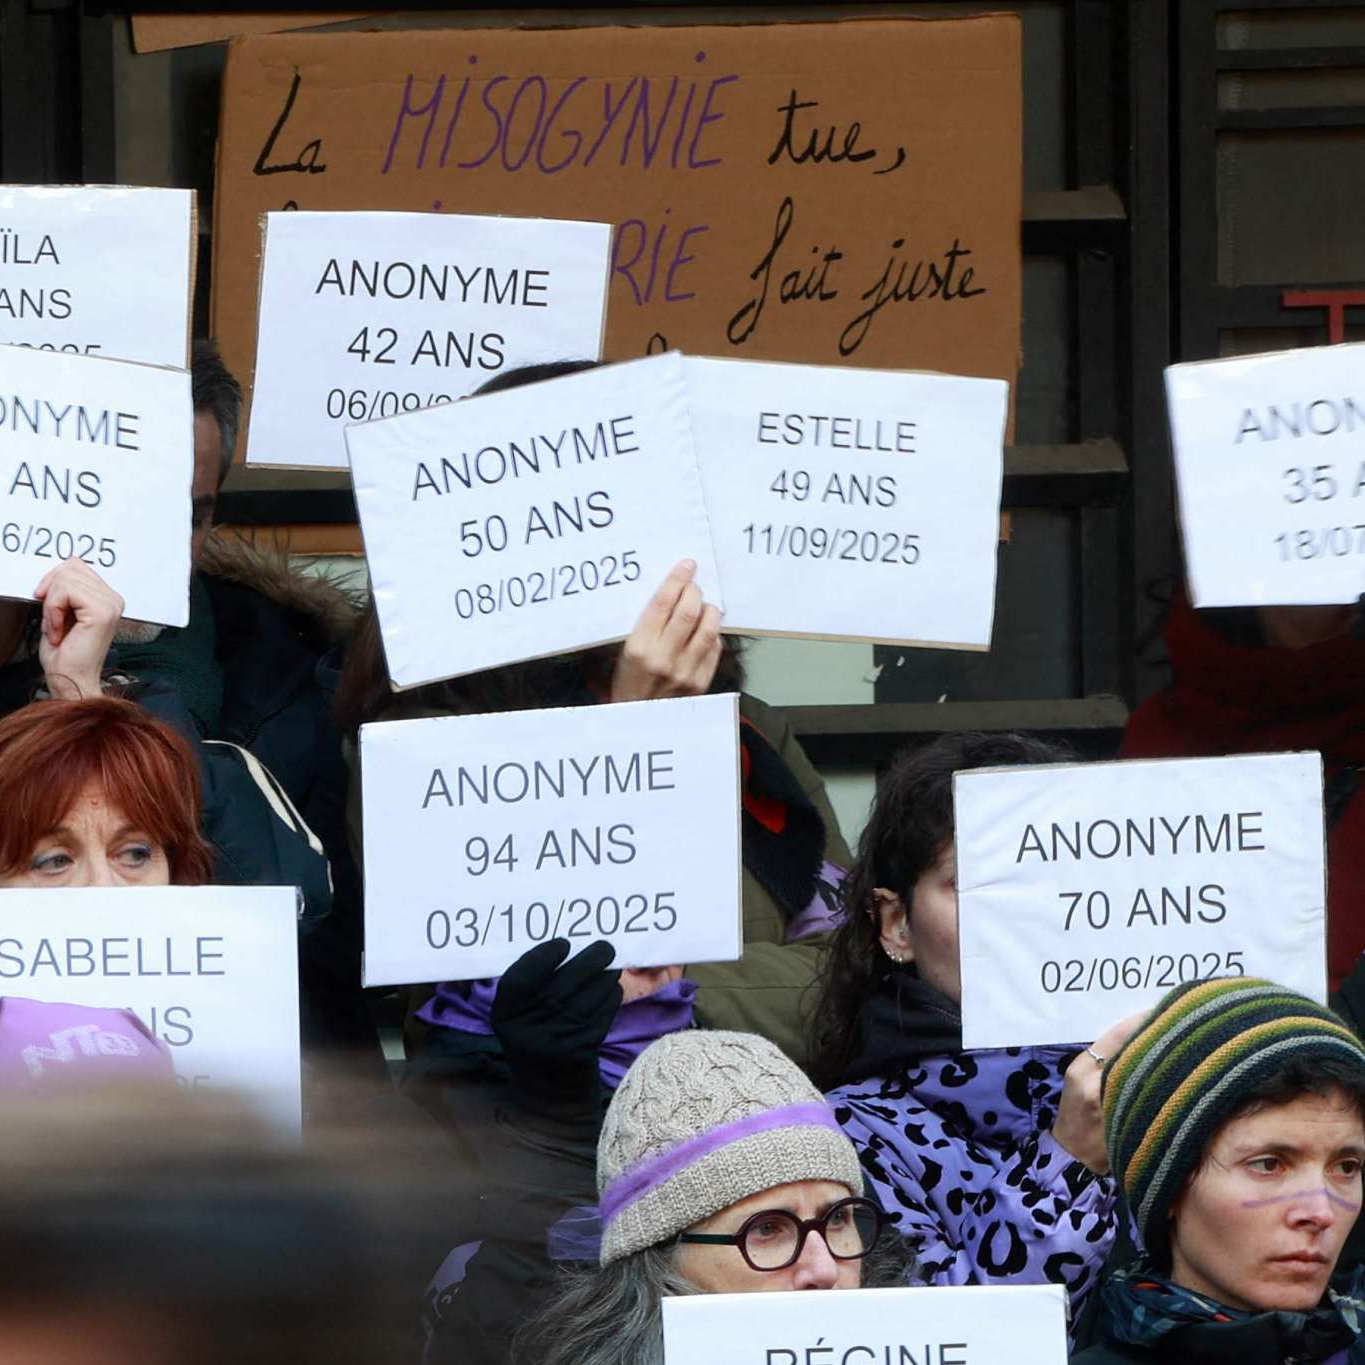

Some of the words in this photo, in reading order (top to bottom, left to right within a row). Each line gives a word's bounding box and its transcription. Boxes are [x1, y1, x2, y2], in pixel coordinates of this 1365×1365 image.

[252, 65, 328, 178] La
[767, 88, 907, 175] tue,
[315, 258, 550, 307] ANONYME
[726, 197, 844, 347] fait
[837, 238, 987, 357] juste
[347, 326, 398, 364] 42
[410, 330, 507, 371] ANS
[757, 412, 917, 453] ESTELLE
[412, 415, 645, 502] ANONYME
[9, 462, 101, 508] ANS
[770, 469, 810, 501] 49
[822, 472, 897, 507] ANS
[1282, 463, 1338, 505] 35
[460, 515, 507, 558] 50
[525, 491, 619, 545] ANS
[743, 523, 920, 565] 11/09/2025
[455, 551, 647, 622] 08/02/2025
[422, 750, 675, 809] ANONYME
[465, 834, 518, 876] 94
[536, 824, 636, 870] ANS
[1016, 811, 1265, 863] ANONYME
[426, 891, 677, 952] 03/10/2025
[1059, 891, 1110, 931] 70
[1126, 884, 1226, 928] ANS
[1039, 952, 1247, 994] 02/06/2025
